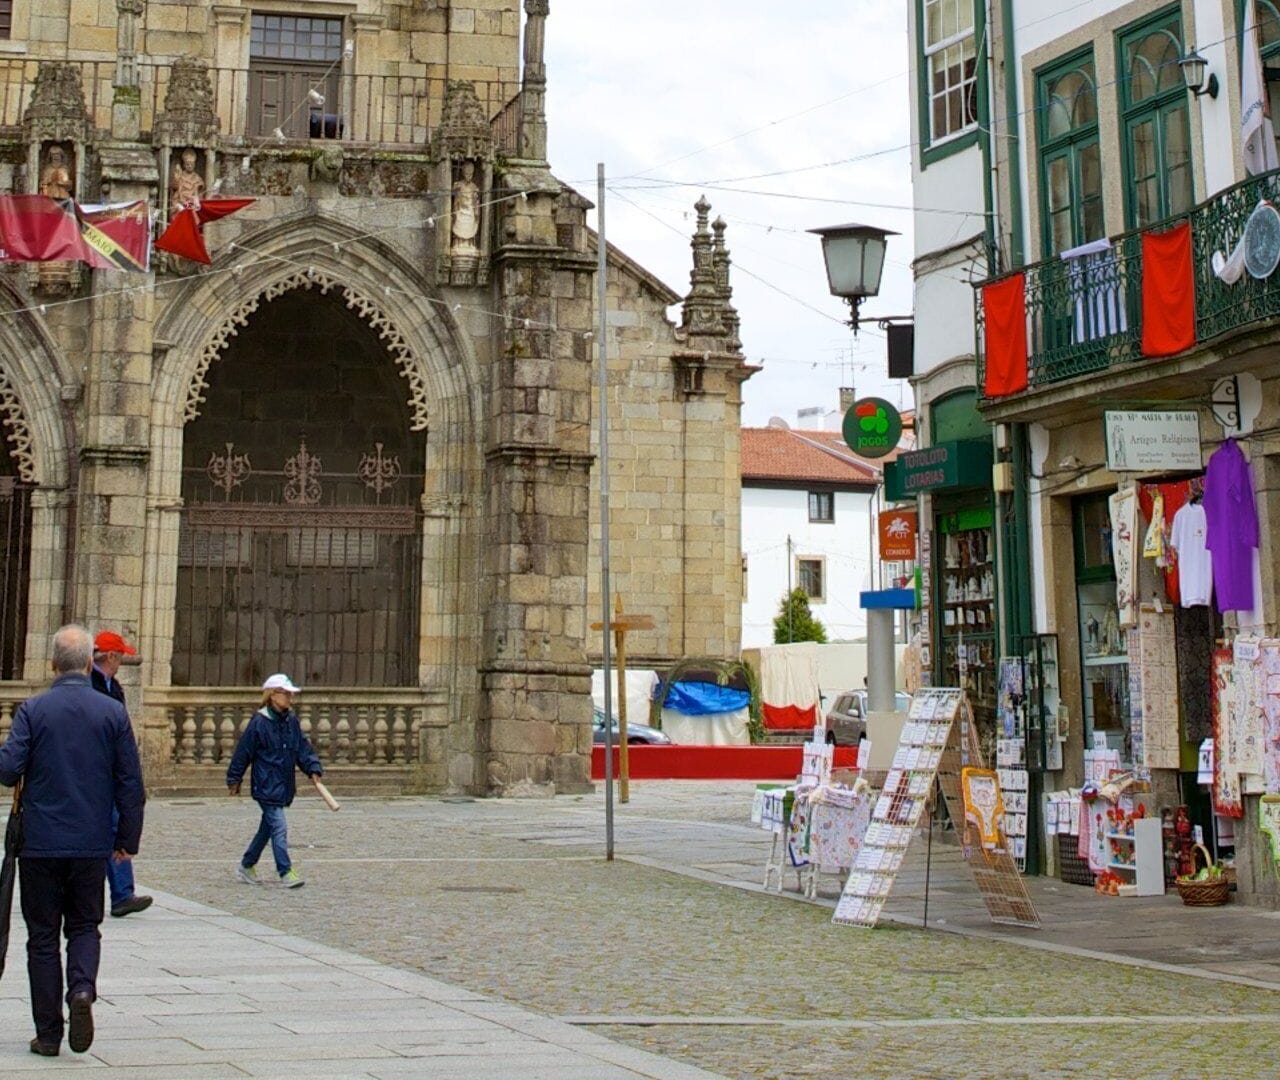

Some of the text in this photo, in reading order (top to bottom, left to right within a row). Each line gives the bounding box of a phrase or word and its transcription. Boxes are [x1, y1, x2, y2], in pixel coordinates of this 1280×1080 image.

[857, 435, 889, 449] JOGOS
[1130, 434, 1157, 446] Artigos
[903, 447, 948, 469] TOTOLOTO
[904, 469, 945, 490] LOTARIAS
